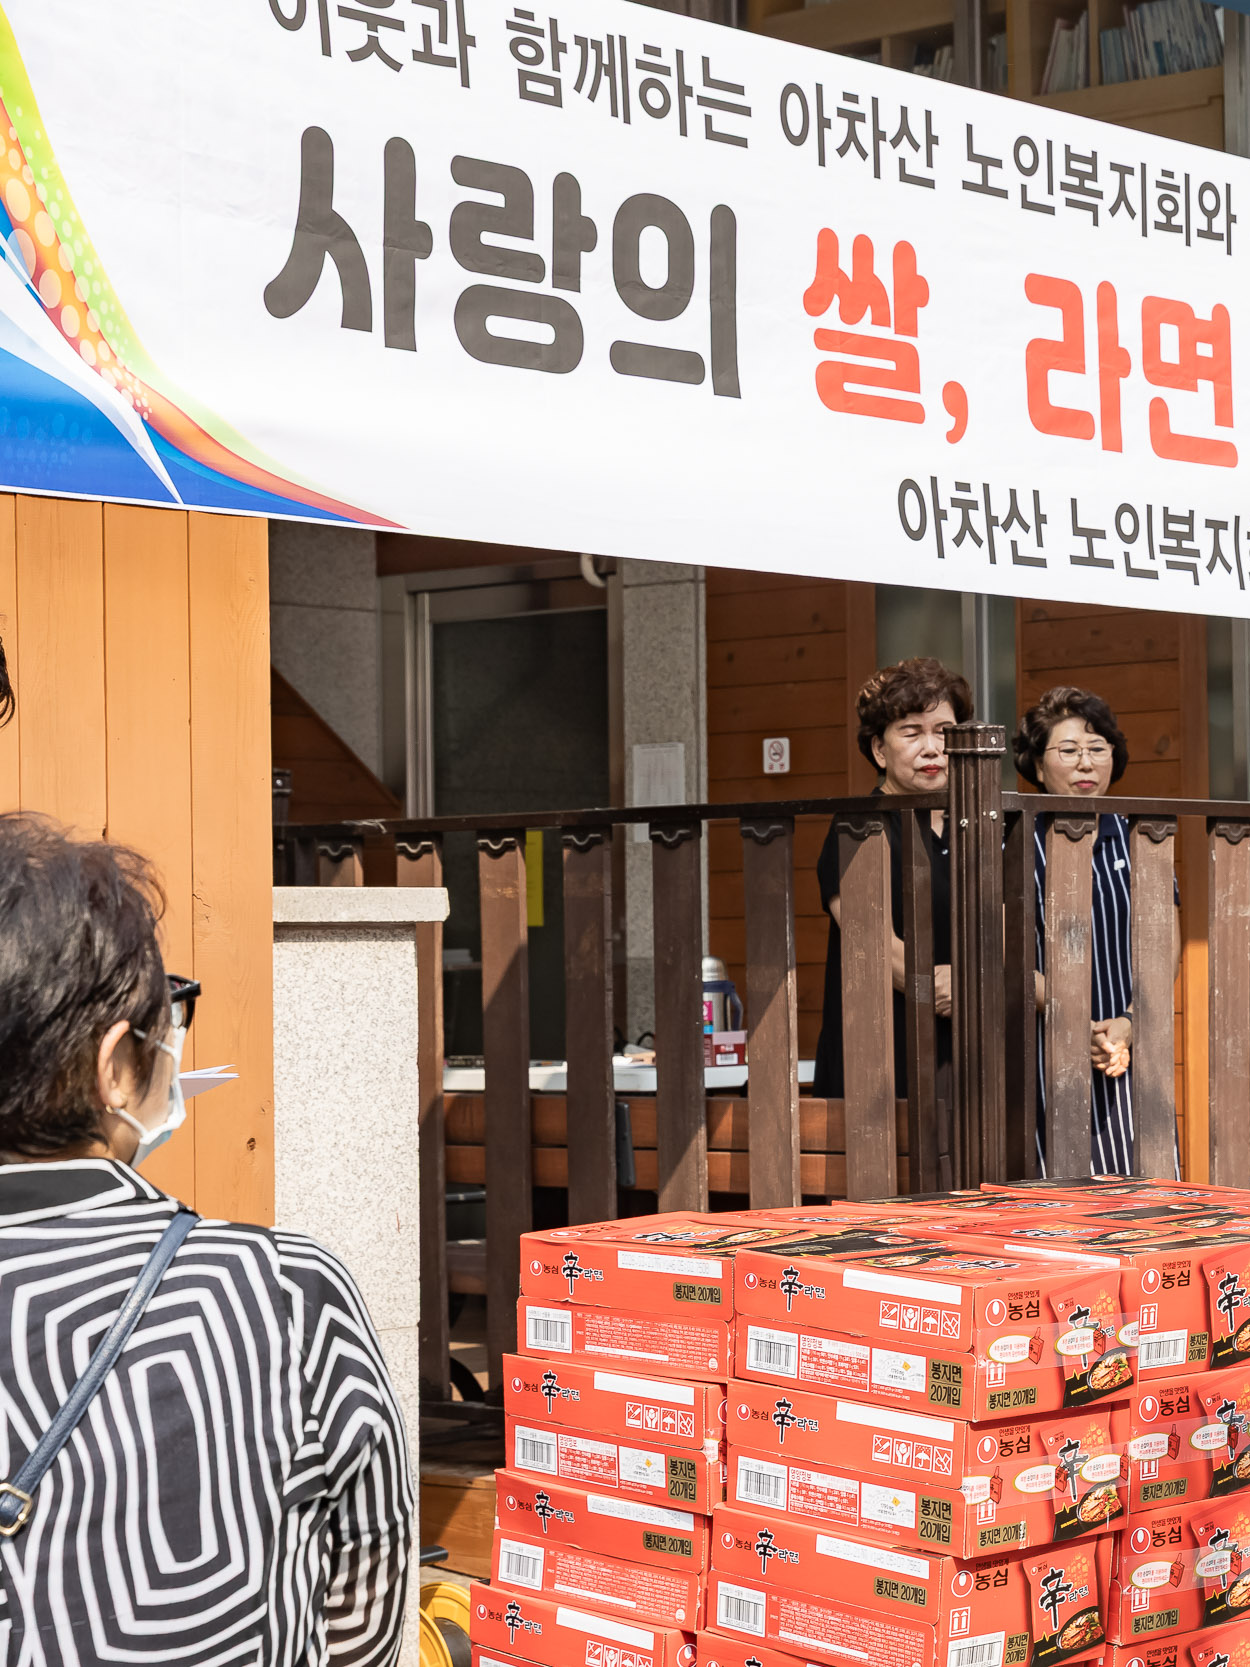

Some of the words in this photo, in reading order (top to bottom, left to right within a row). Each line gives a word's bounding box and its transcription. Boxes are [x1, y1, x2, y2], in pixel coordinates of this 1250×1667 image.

[506, 8, 752, 148] 함께하는
[780, 82, 938, 190] 아차산
[961, 122, 1237, 256] 노인복지회와
[263, 125, 742, 399] 사랑의
[803, 227, 969, 444] 쌀,
[1024, 271, 1239, 469] 라면
[897, 476, 1048, 571] 아차산
[1161, 1269, 1191, 1289] 농심
[674, 1284, 696, 1300] 봉지면
[697, 1286, 721, 1304] 20개입
[1008, 1300, 1040, 1321] 농심
[1189, 1332, 1209, 1348] 봉지면
[1188, 1348, 1207, 1362] 20개입
[930, 1360, 962, 1384] 봉지면
[930, 1384, 961, 1406] 20개입
[988, 1390, 1011, 1410] 봉지면
[1012, 1387, 1037, 1406] 20개입
[1160, 1395, 1190, 1416] 농심
[999, 1435, 1031, 1458] 농심
[668, 1458, 696, 1479] 봉지면
[669, 1480, 696, 1501] 20개입
[1142, 1483, 1163, 1501] 봉지면
[1164, 1479, 1187, 1496] 20개입
[919, 1497, 952, 1521] 봉지면
[919, 1521, 951, 1543] 20개입
[979, 1529, 1001, 1547] 봉지면
[1151, 1526, 1182, 1548] 농심
[645, 1532, 667, 1550] 봉지면
[668, 1537, 693, 1556] 20개입
[975, 1568, 1009, 1591] 농심
[875, 1578, 900, 1598] 봉지면
[900, 1583, 926, 1606] 20개입
[1133, 1614, 1155, 1633] 봉지면
[1155, 1609, 1179, 1627] 20개입
[1007, 1634, 1029, 1650] 봉지면
[1005, 1650, 1028, 1664] 20개입
